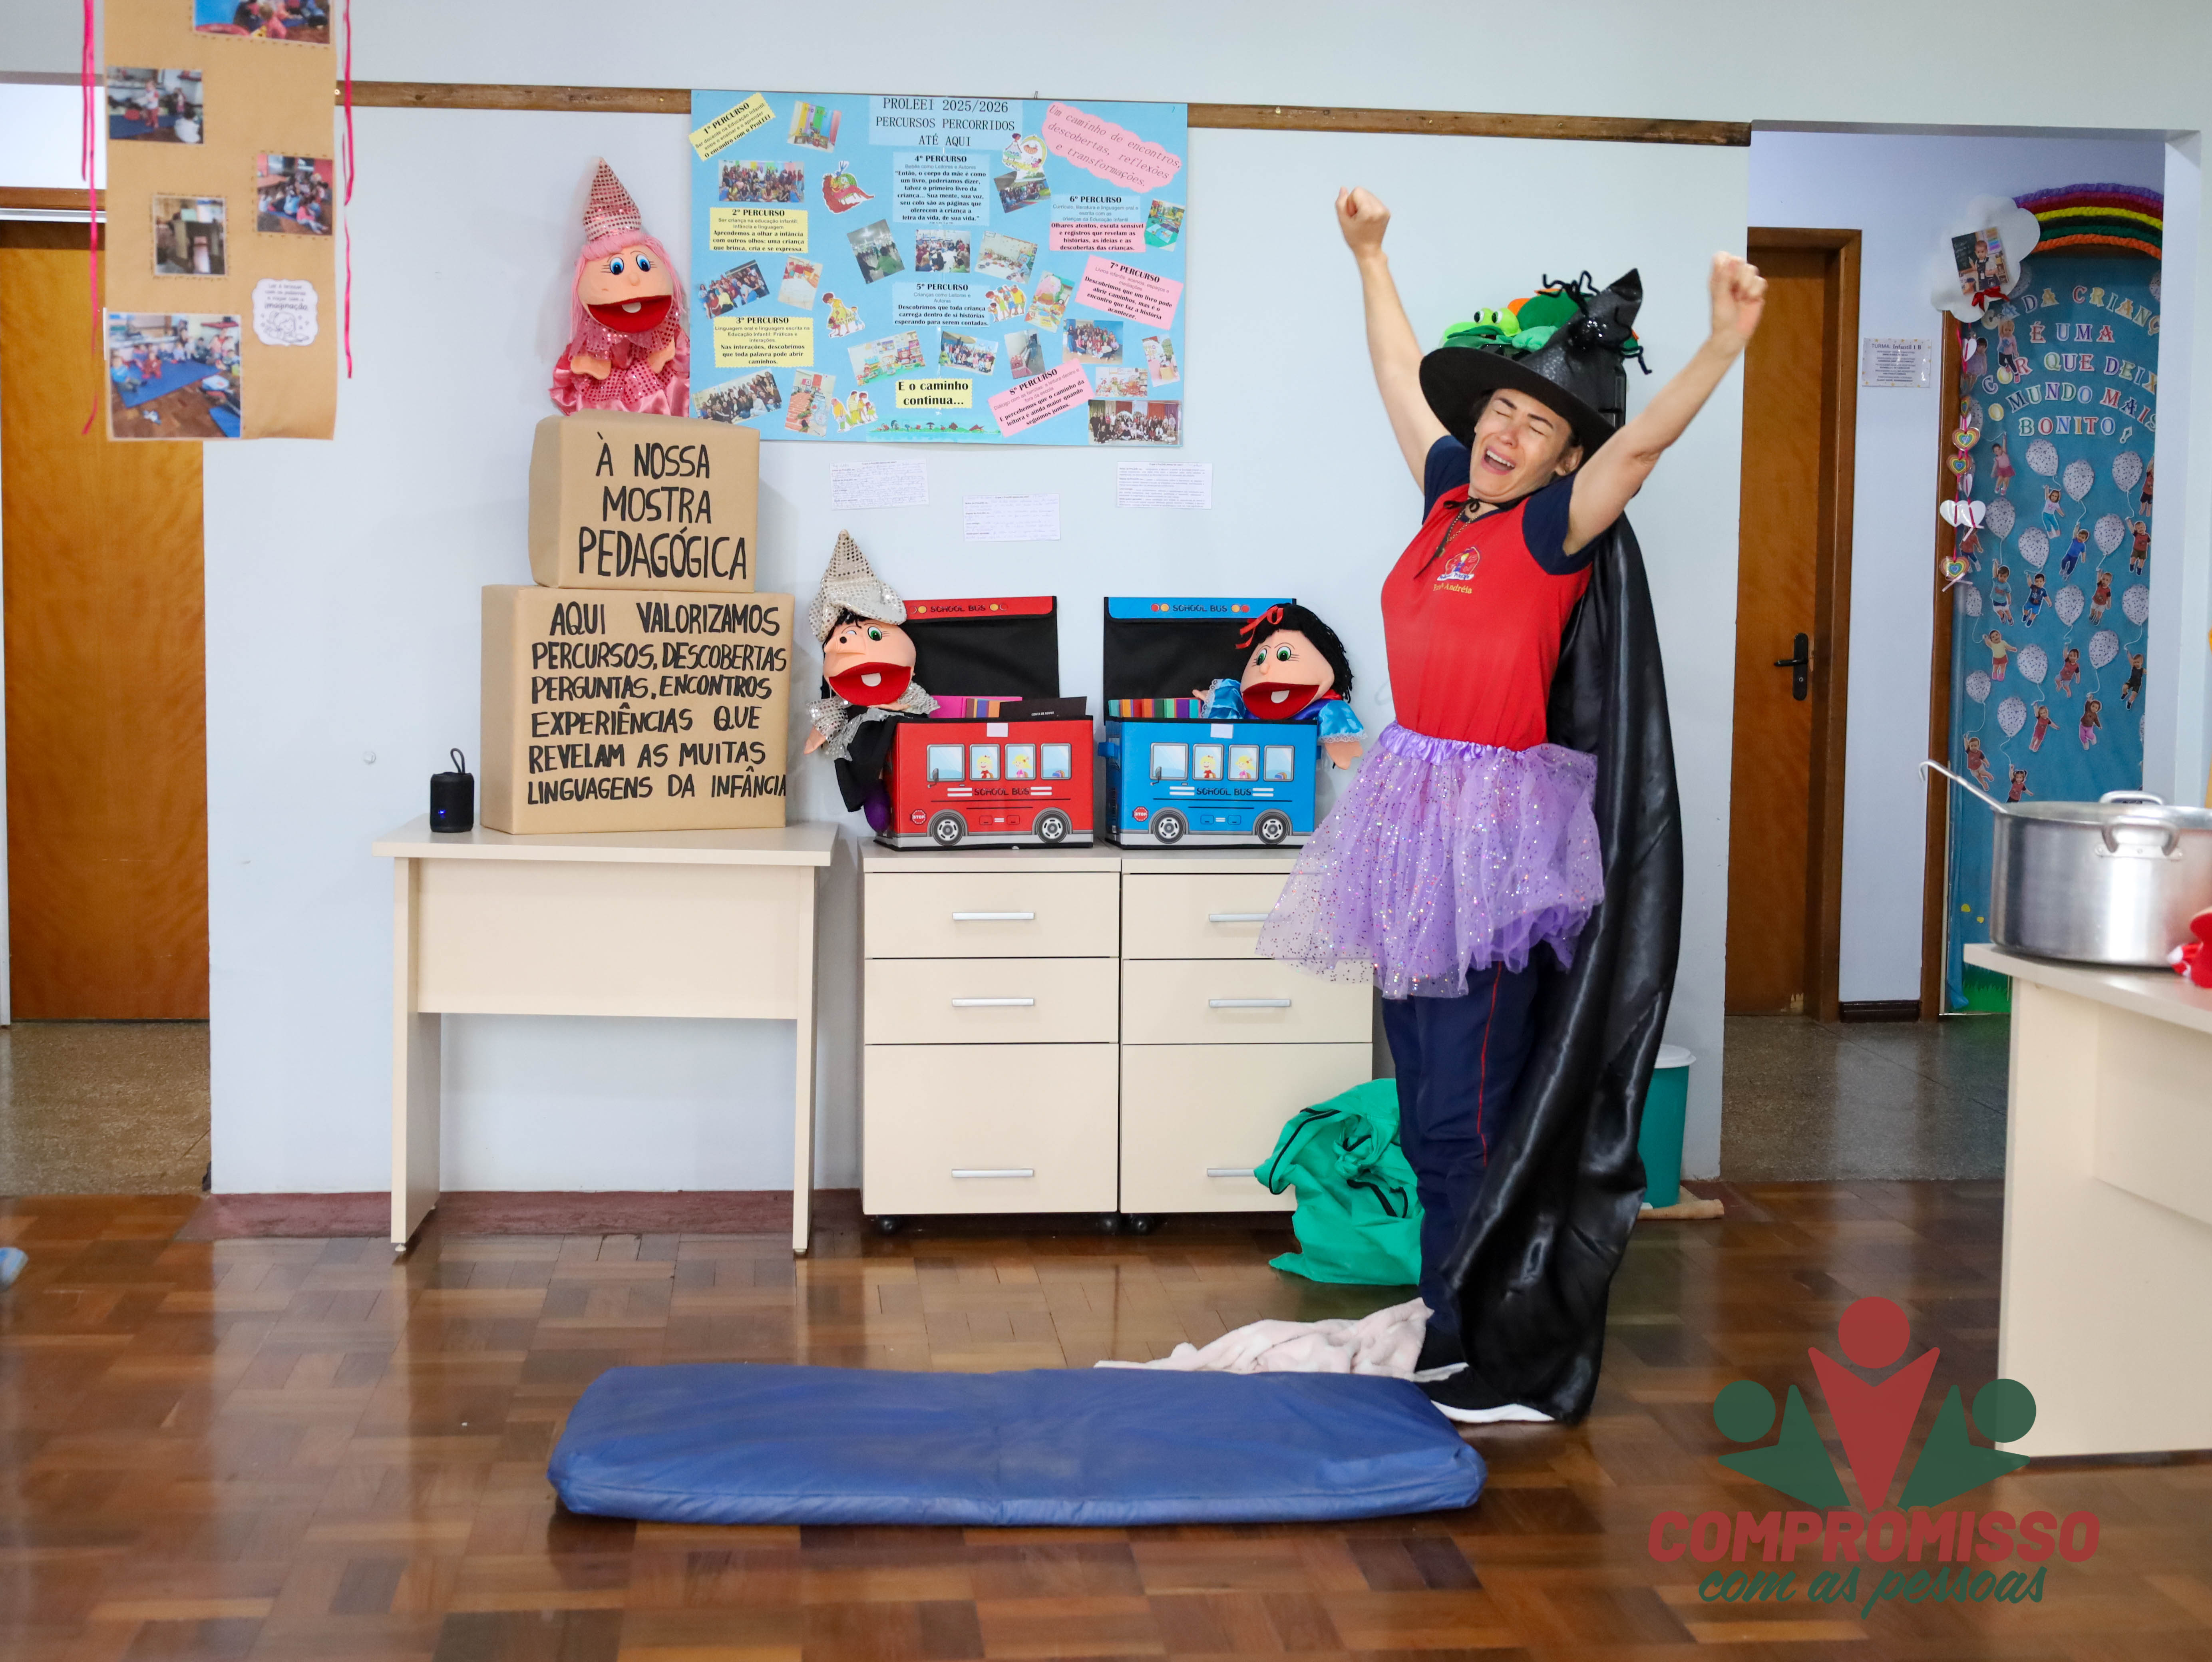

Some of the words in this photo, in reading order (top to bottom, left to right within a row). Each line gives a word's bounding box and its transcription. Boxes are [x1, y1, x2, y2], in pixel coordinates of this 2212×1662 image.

[712, 103, 749, 129] PERCURSO
[943, 99, 1008, 113] 2025/2026
[876, 116, 935, 128] PERCURSOS
[943, 118, 1014, 131] PERCORRIDOS
[1049, 105, 1062, 116] Um
[1066, 114, 1106, 135] caminho
[1111, 133, 1123, 143] de
[1128, 141, 1181, 169] encontros,
[711, 139, 733, 155] encontro
[734, 131, 745, 140] com
[919, 133, 939, 145] ATÉ
[945, 136, 971, 147] AQUI
[1048, 123, 1110, 156] descobertas,
[1120, 153, 1169, 179] reflexões
[1068, 148, 1145, 187] transformações.
[1085, 276, 1121, 291] Descobrimos
[1120, 266, 1160, 283] PERCURSO
[2073, 285, 2160, 336] CRIANÇ
[2030, 321, 2046, 343] É
[2056, 323, 2115, 343] UMA
[899, 382, 904, 391] E
[920, 381, 968, 390] caminho
[1019, 369, 1057, 390] PERCURSO
[1982, 357, 2033, 395] COR
[2044, 352, 2095, 372] QUE
[2103, 356, 2157, 395] DEIX
[903, 396, 963, 406] continua...
[1988, 403, 2004, 421] O
[2005, 382, 2093, 414] MUNDO
[1026, 411, 1051, 425] seguimos
[596, 431, 613, 476] À
[635, 443, 709, 479] NOSSA
[603, 486, 711, 524] MOSTRA
[579, 526, 746, 580] PEDAGÓGICA
[1444, 584, 1472, 594] Andréia
[549, 601, 605, 636] AQUI
[636, 602, 780, 636] VALORIZAMOS
[532, 641, 658, 671] PERCURSOS,
[662, 642, 787, 672] DESCOBERTAS
[531, 676, 656, 704] PERGUNTAS,
[659, 674, 772, 700] ENCONTROS
[531, 702, 693, 738] EXPERIÊNCIAS
[714, 706, 762, 731] QUE
[529, 744, 625, 774] REVELAM
[637, 744, 668, 768] AS
[679, 741, 766, 767] MUITAS
[528, 776, 652, 805] LINGUAGENS
[668, 774, 695, 798] DA
[711, 766, 786, 798] INFÂNCIA
